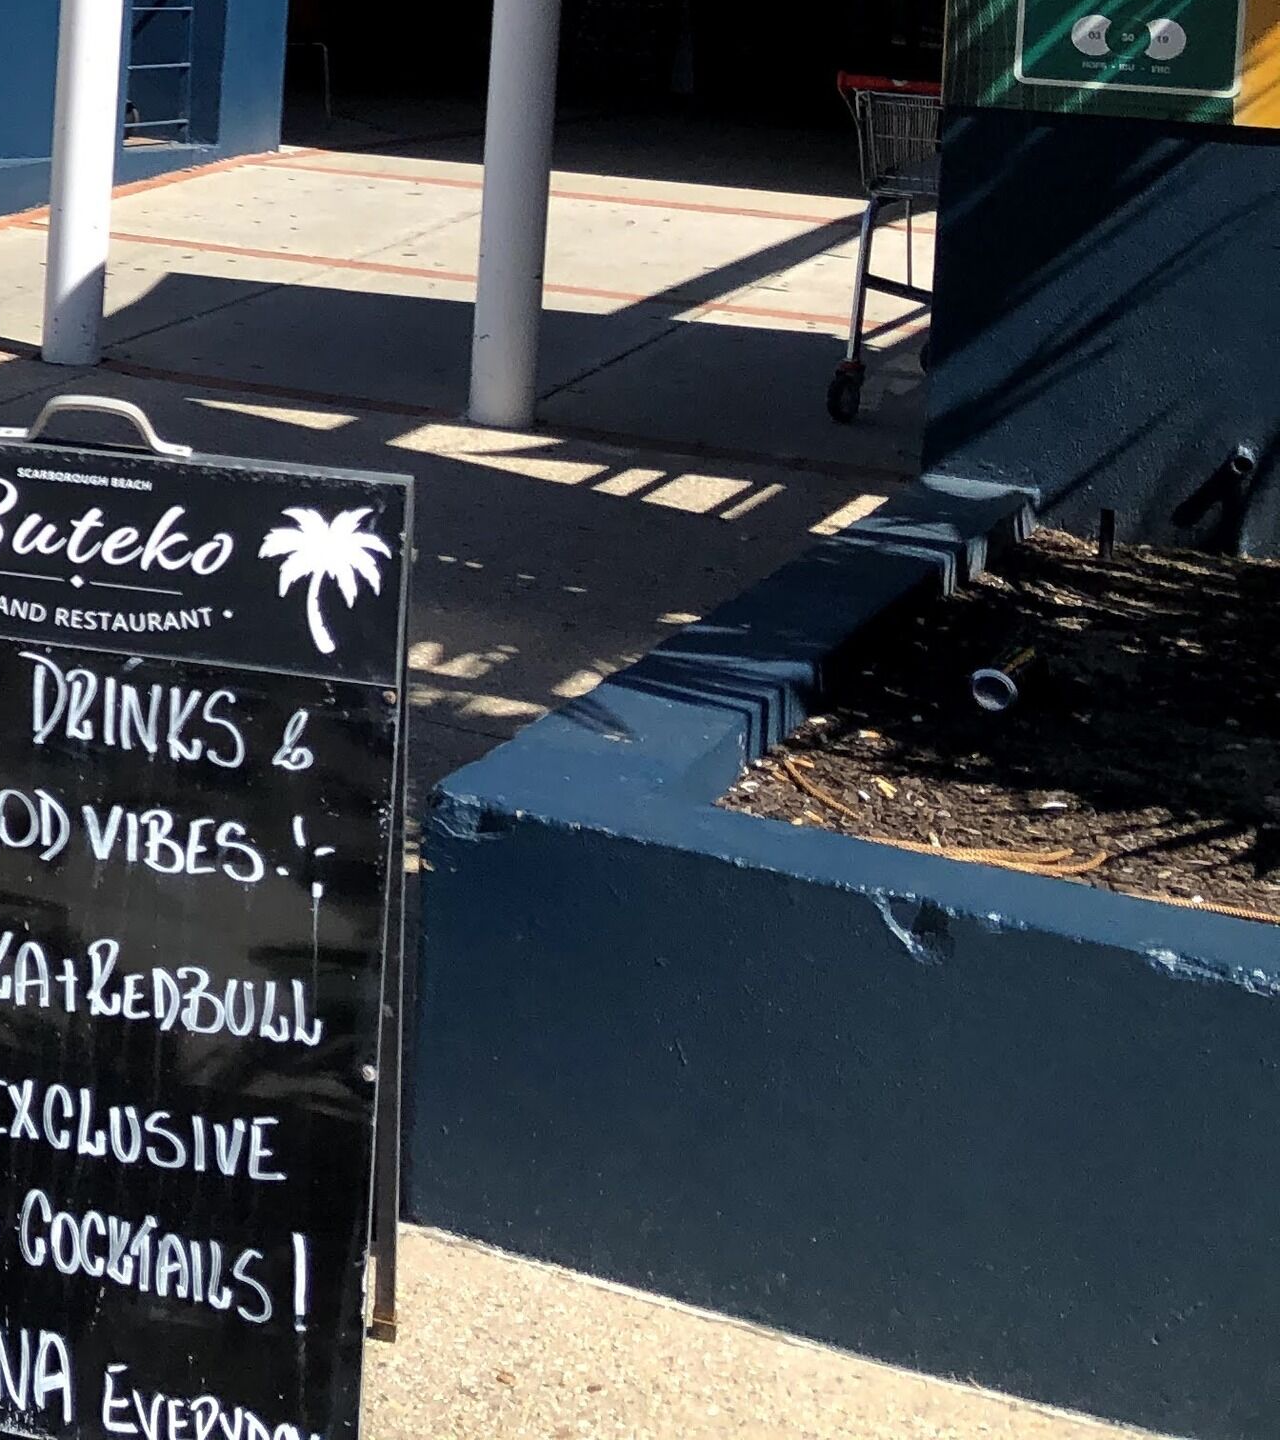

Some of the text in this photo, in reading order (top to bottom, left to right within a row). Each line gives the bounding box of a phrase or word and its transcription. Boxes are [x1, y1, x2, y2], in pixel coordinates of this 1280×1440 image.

[17, 466, 153, 492] SCARBOROUGH BEACH
[54, 606, 214, 633] RESTAURANT
[18, 650, 246, 768] DRINKS
